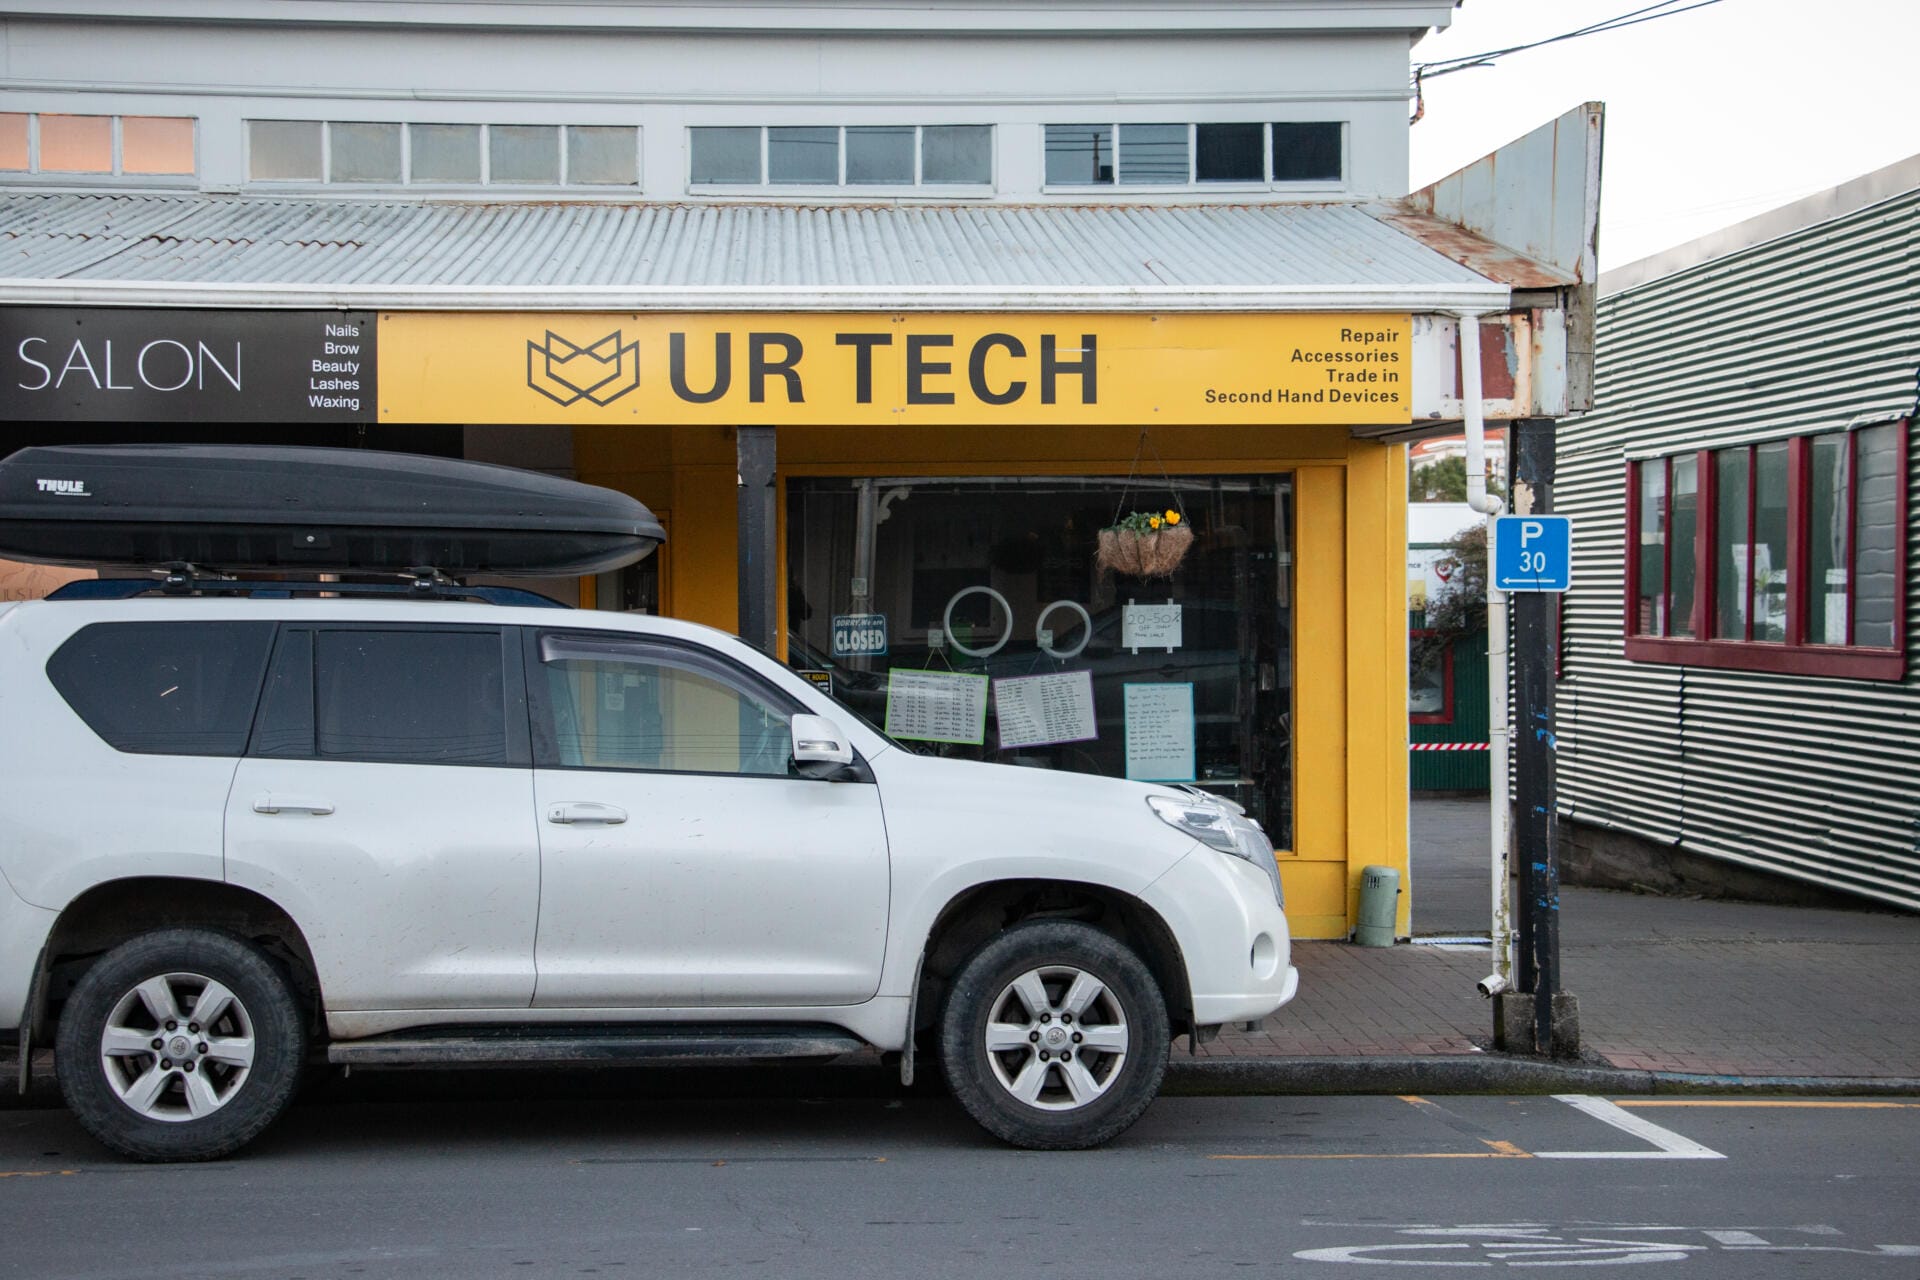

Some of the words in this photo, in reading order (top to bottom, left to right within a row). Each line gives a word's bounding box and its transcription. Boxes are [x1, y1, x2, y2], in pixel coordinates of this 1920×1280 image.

[325, 324, 359, 337] Nails
[1341, 328, 1399, 345] Repair
[324, 342, 360, 355] Brow
[1290, 348, 1399, 363] Accessories
[18, 337, 241, 391] SALON
[312, 360, 360, 375] Beauty
[669, 332, 805, 404] UR
[835, 332, 1098, 405] TECH
[1326, 368, 1378, 383] Trade
[1383, 368, 1399, 383] in
[310, 378, 360, 391] Lashes
[308, 395, 360, 411] Waxing
[1205, 388, 1272, 403] Second
[1278, 388, 1324, 403] Hand
[1329, 388, 1399, 403] Devices
[36, 479, 84, 492] THULE
[1521, 521, 1544, 549] P
[1519, 551, 1546, 573] 30
[835, 629, 884, 651] CLOSED
